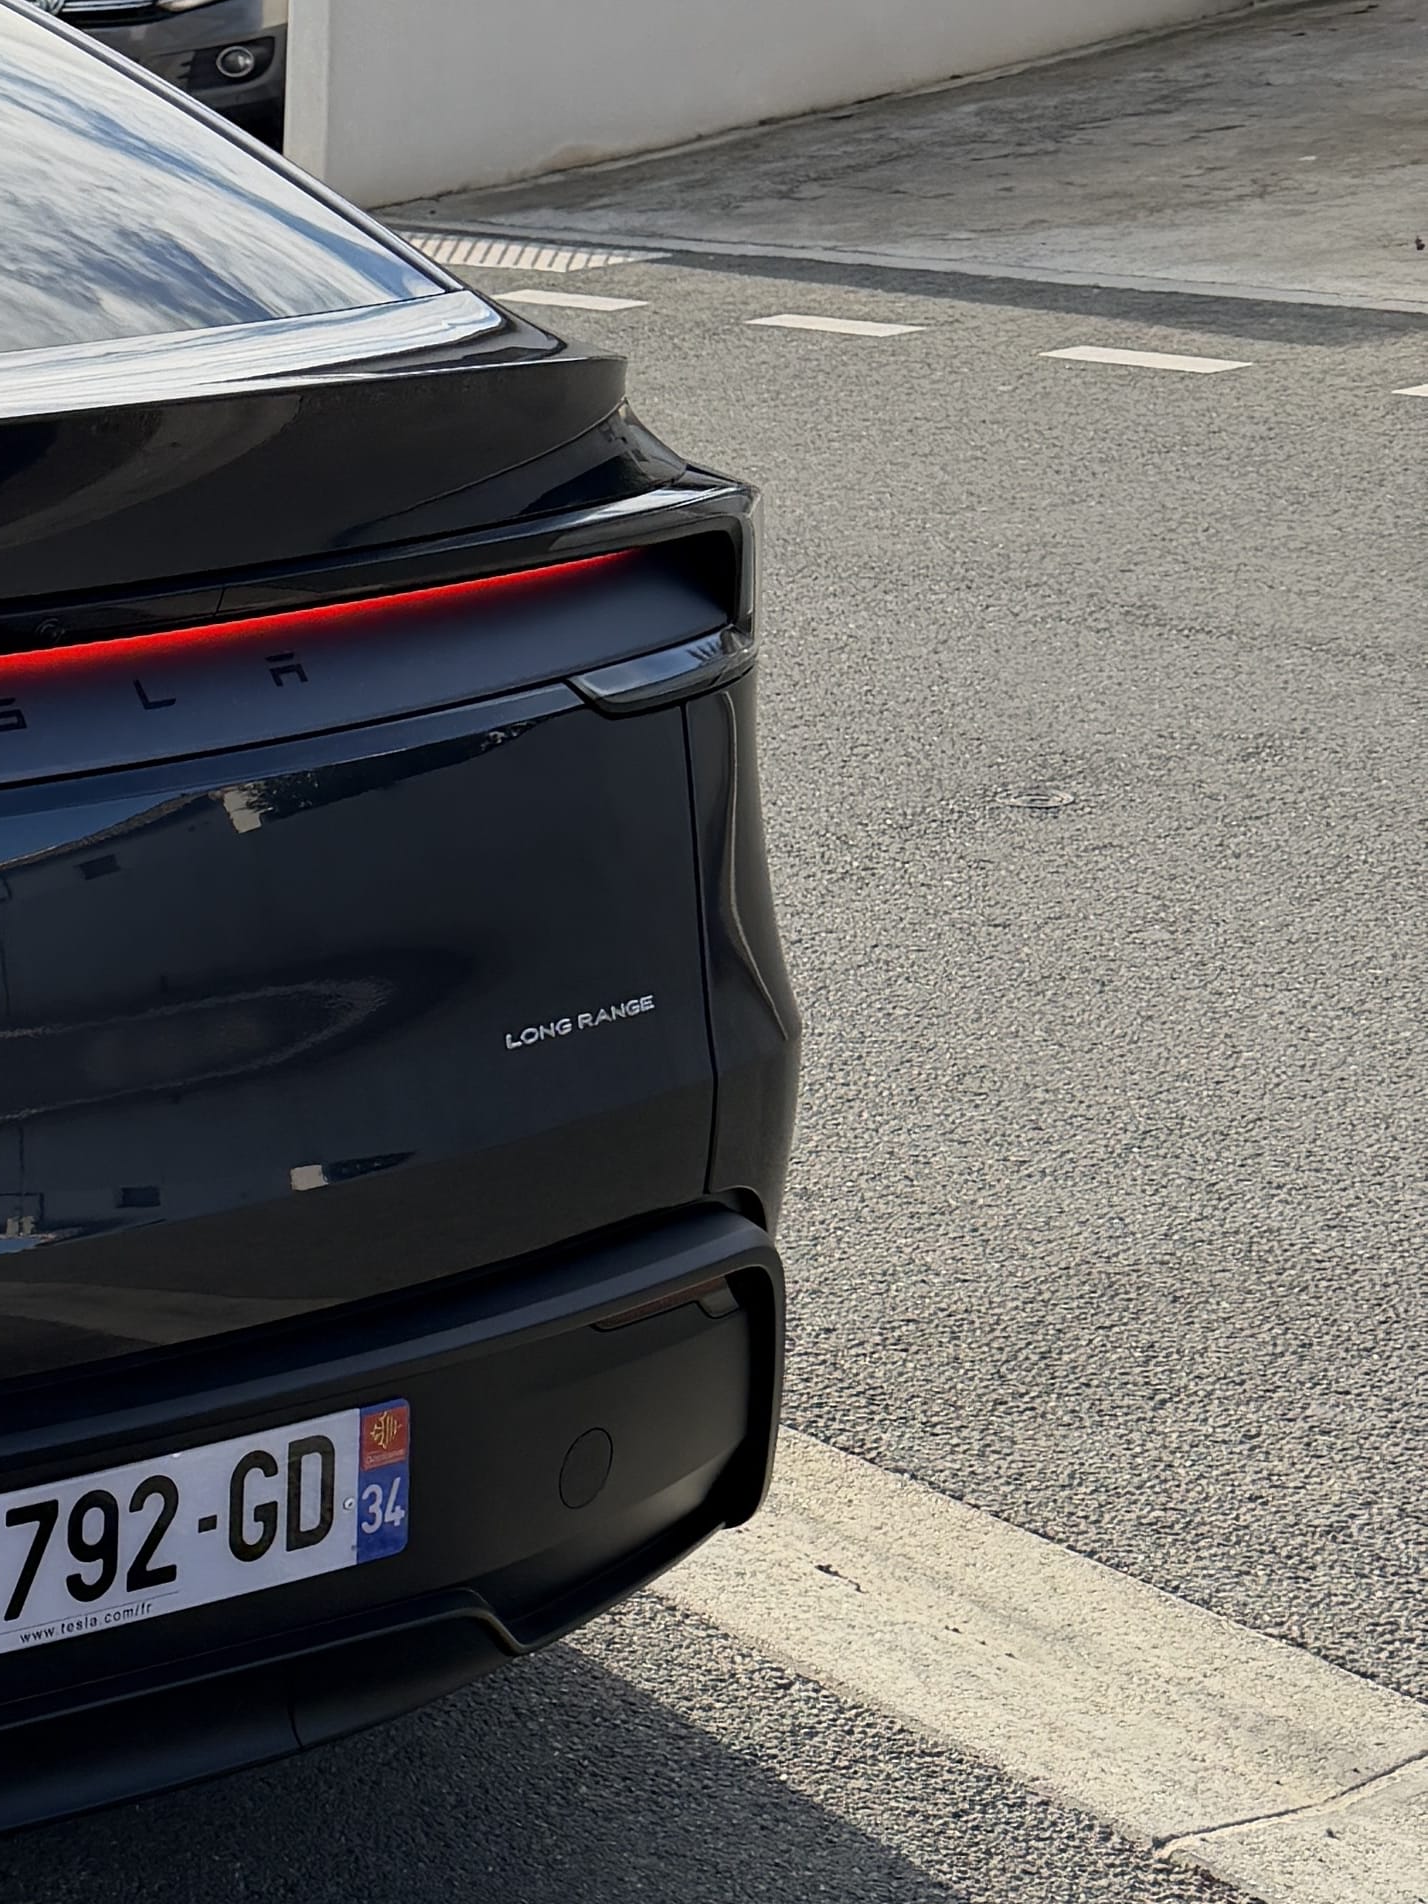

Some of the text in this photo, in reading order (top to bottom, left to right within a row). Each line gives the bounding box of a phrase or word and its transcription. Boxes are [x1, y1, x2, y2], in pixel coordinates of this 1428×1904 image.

[505, 995, 655, 1049] LONG RANGE
[361, 1476, 405, 1536] 34
[19, 1602, 153, 1644] www.tesla.com/fr
